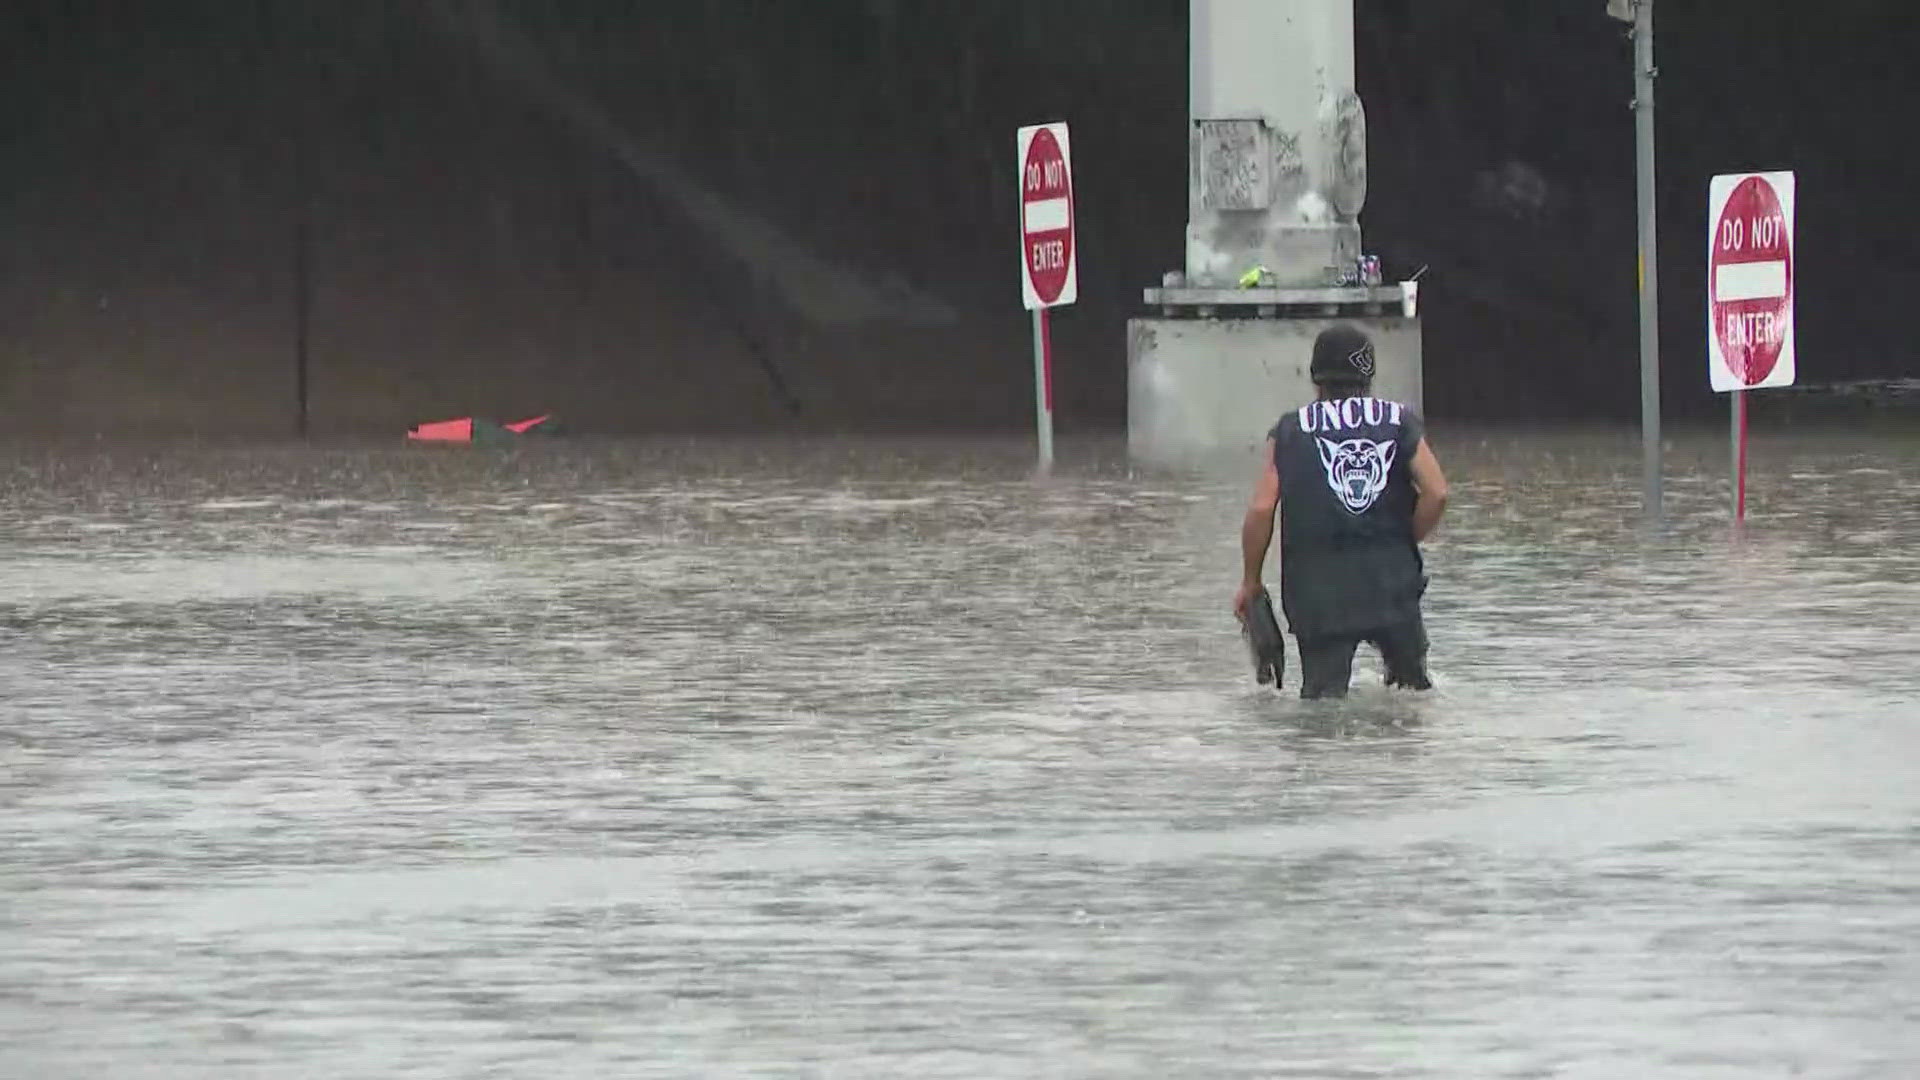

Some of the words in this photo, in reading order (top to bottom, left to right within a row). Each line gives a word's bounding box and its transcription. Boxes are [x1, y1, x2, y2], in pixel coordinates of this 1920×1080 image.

[1027, 162, 1041, 191] DO
[1045, 159, 1063, 189] NOT
[1722, 217, 1743, 250] DO
[1752, 215, 1782, 248] NOT
[1032, 240, 1064, 271] ENTER
[1727, 311, 1775, 345] ENTER
[1299, 397, 1404, 433] UNCUT
